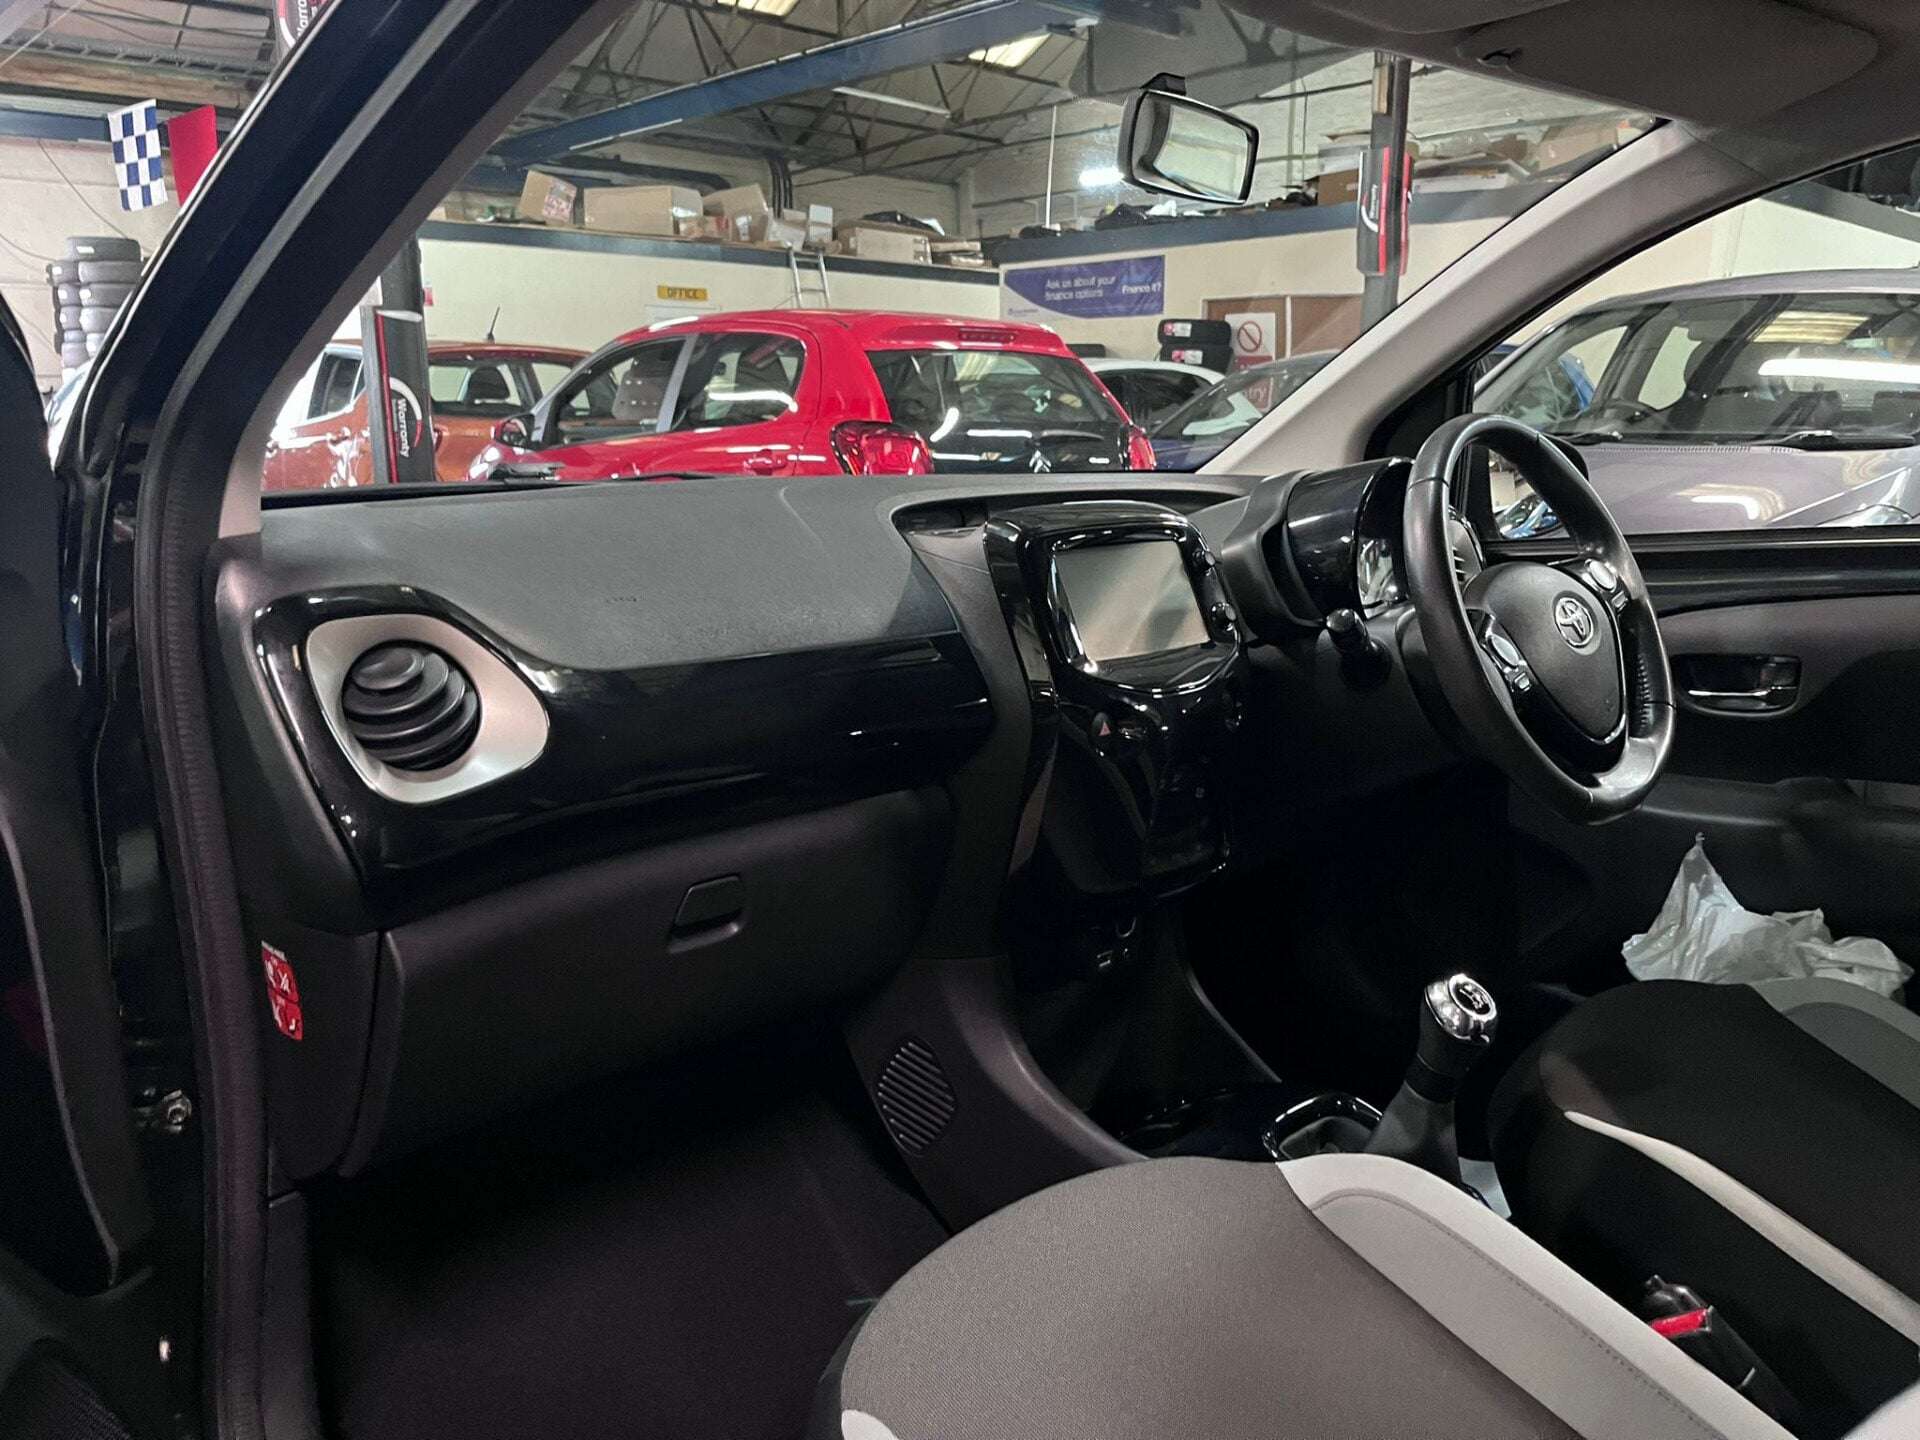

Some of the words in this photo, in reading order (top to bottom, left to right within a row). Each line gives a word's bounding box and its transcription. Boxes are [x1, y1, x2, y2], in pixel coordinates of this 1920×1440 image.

[1046, 280, 1060, 289] Ask
[1073, 277, 1095, 288] about
[1097, 276, 1116, 288] your
[1045, 290, 1074, 300] finance
[398, 398, 409, 457] Warranty
